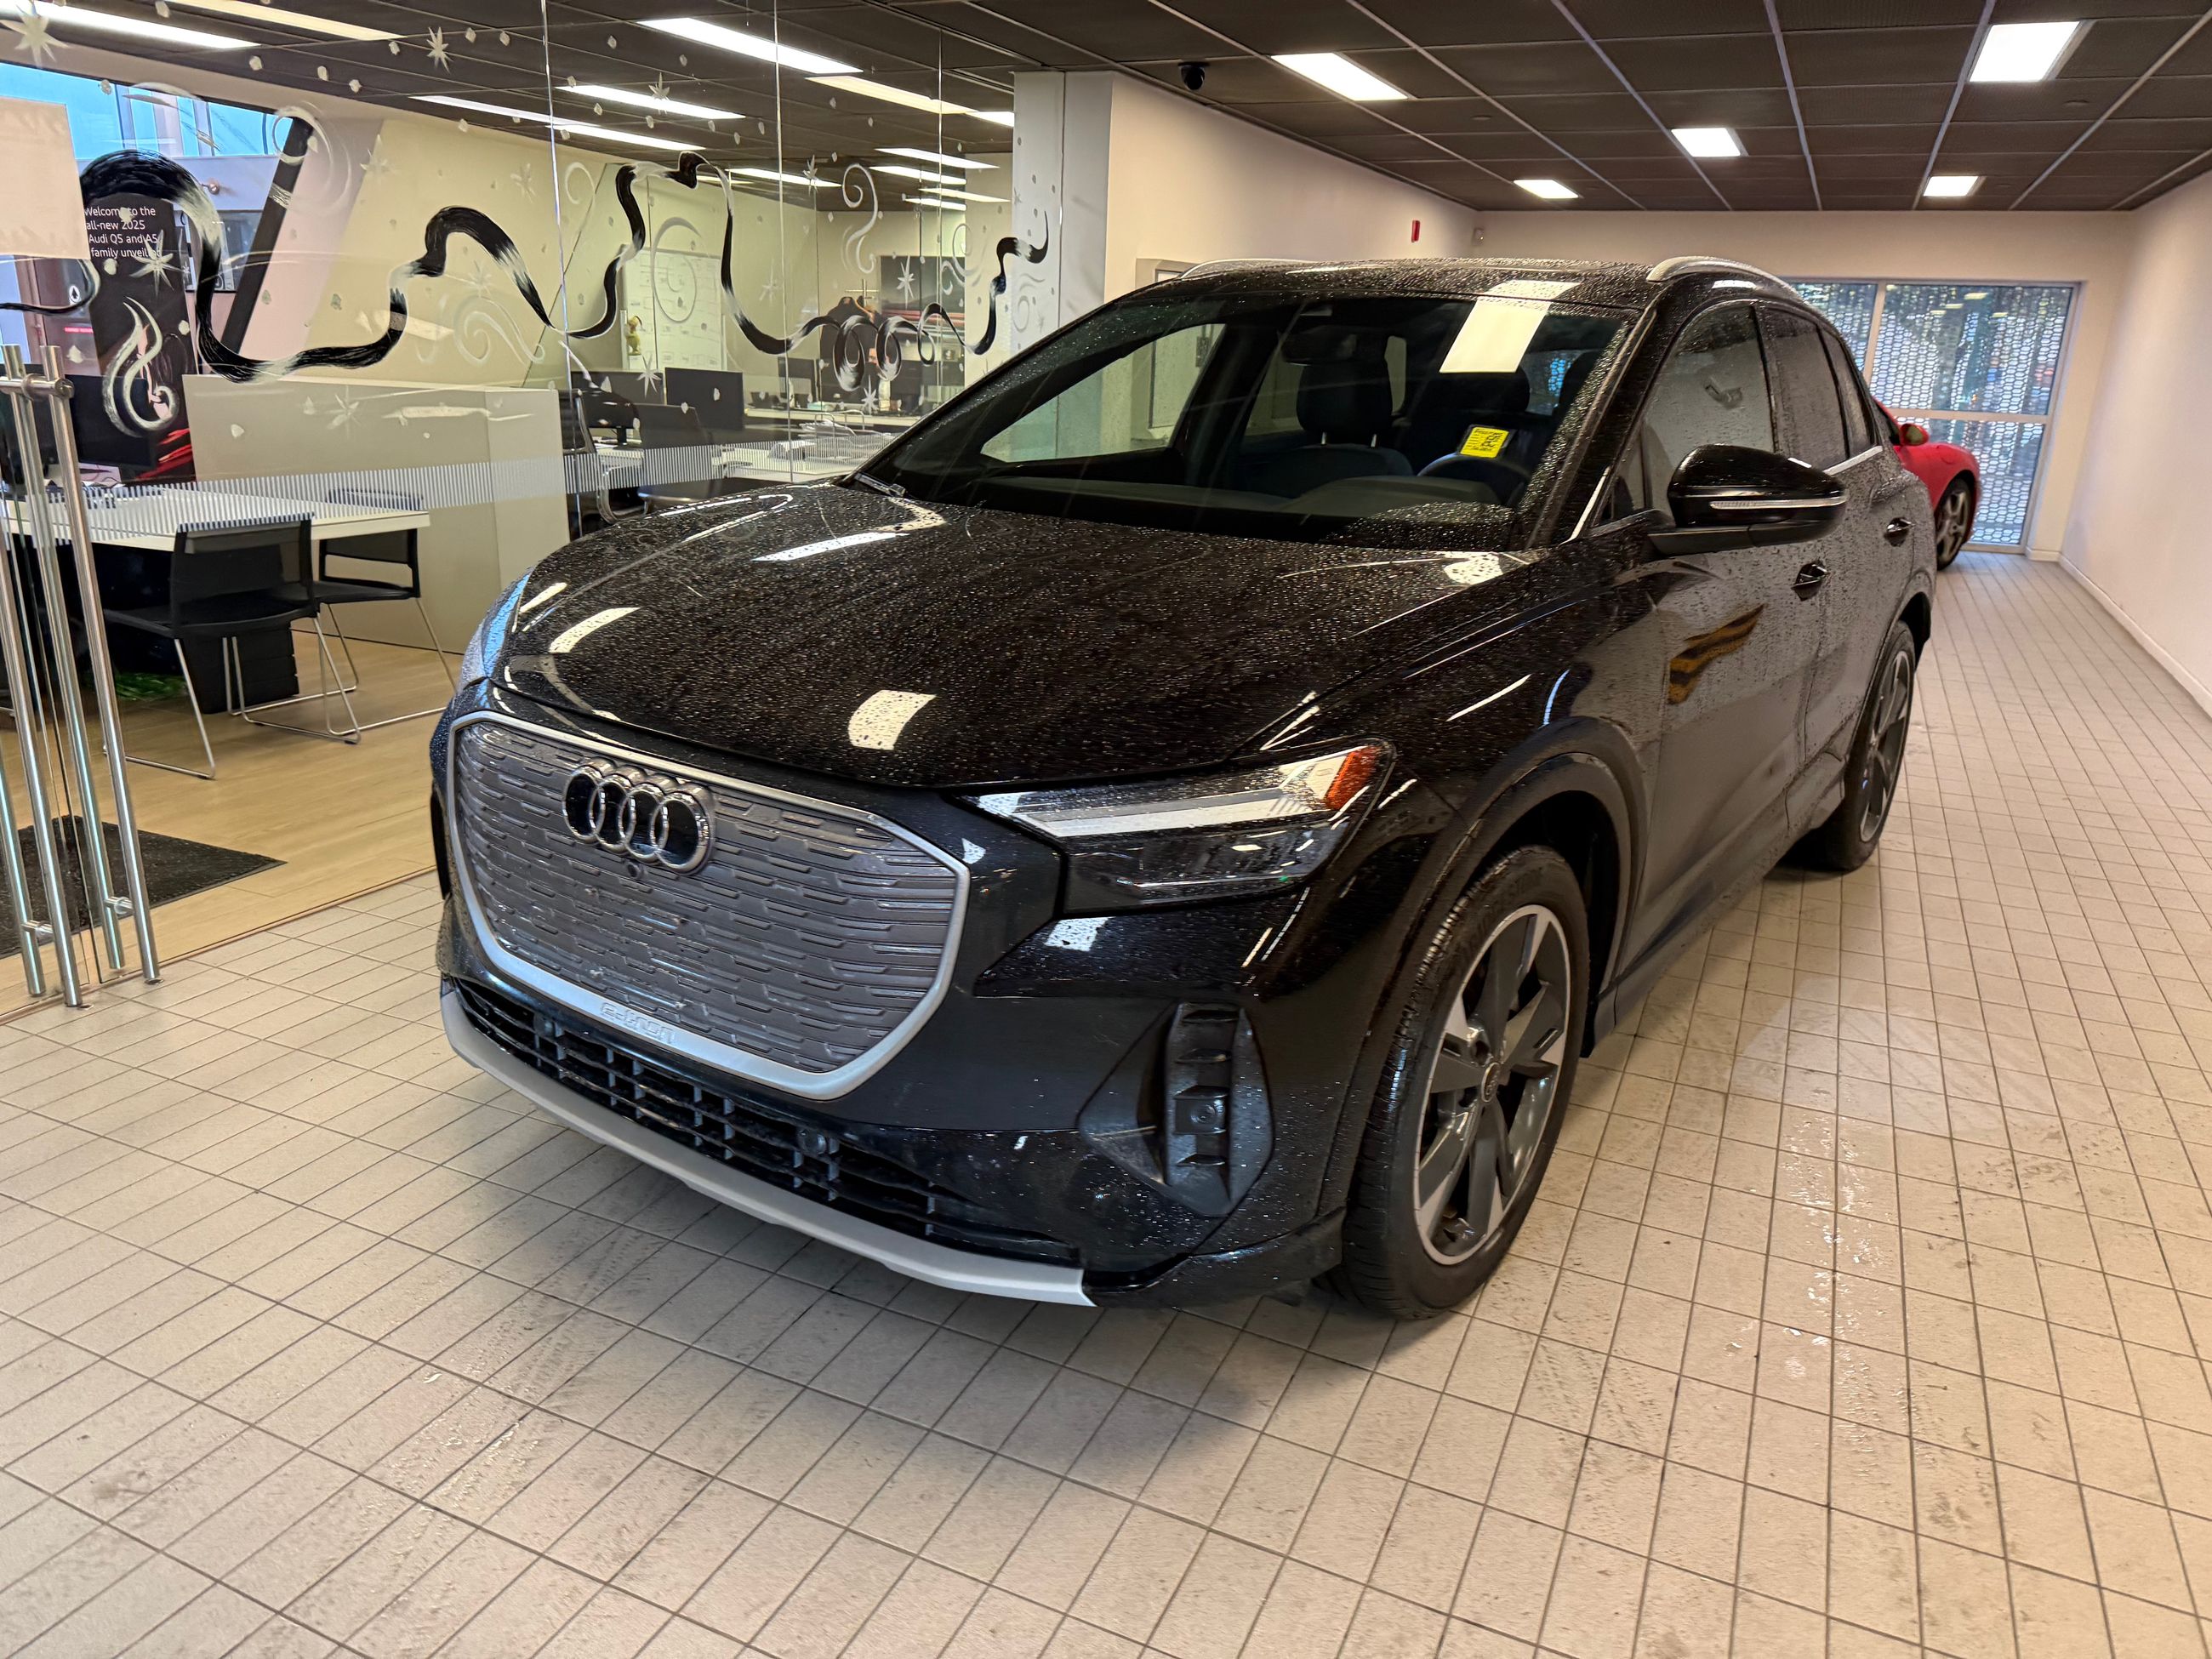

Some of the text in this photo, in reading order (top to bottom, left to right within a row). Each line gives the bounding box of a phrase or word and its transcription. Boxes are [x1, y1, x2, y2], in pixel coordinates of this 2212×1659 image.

[85, 207, 123, 216] Welcom
[140, 207, 156, 216] the
[86, 220, 145, 230] all-new 2025
[89, 234, 158, 244] Audi Q5 and A5
[91, 248, 161, 259] family unveil
